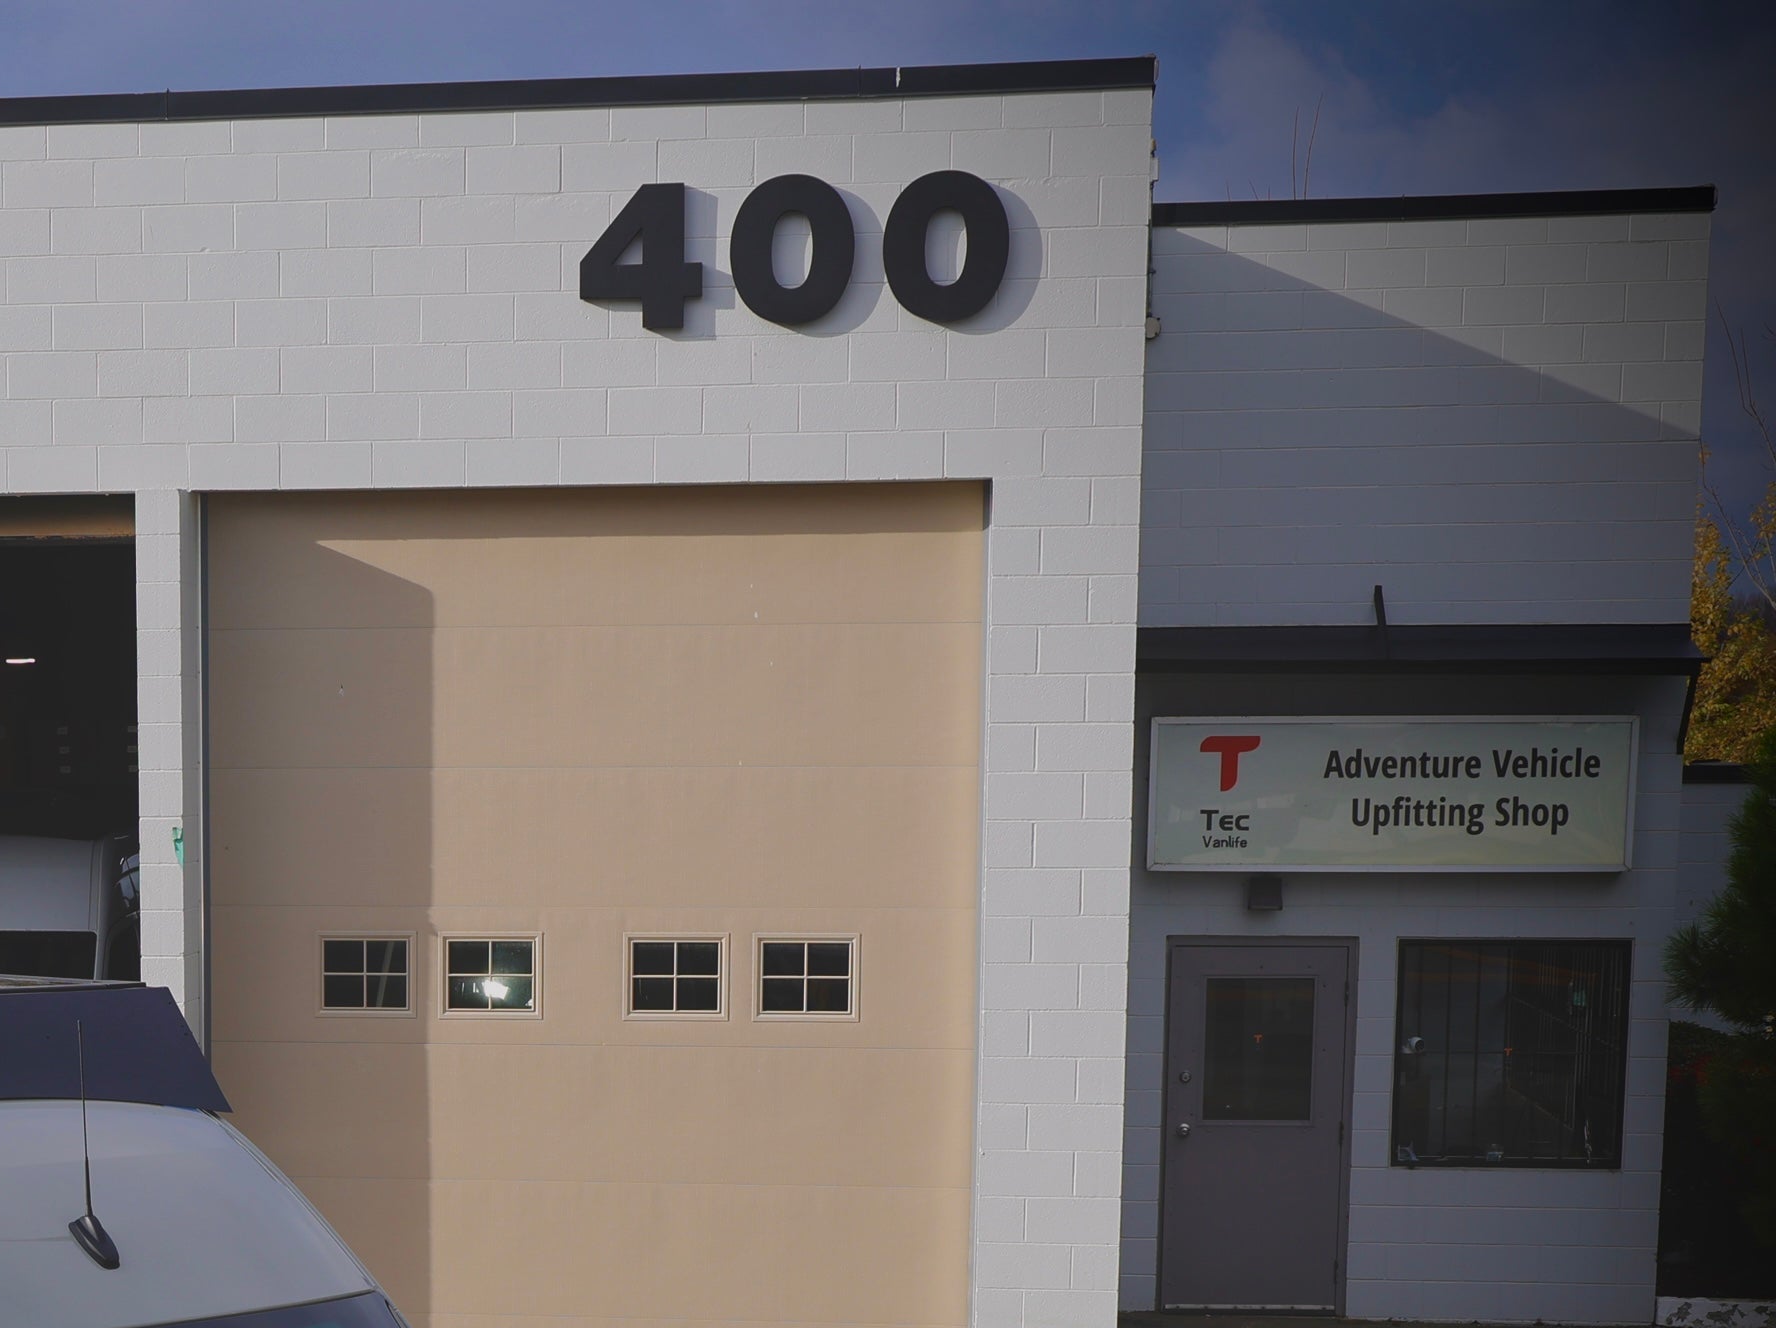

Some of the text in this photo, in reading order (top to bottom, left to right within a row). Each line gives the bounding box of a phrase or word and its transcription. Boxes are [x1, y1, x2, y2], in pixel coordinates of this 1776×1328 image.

[579, 169, 1010, 329] 400
[1324, 746, 1601, 779] Adventure Vehicle
[1351, 796, 1569, 835] Upfitting Shop
[1202, 835, 1248, 848] Vanlife
